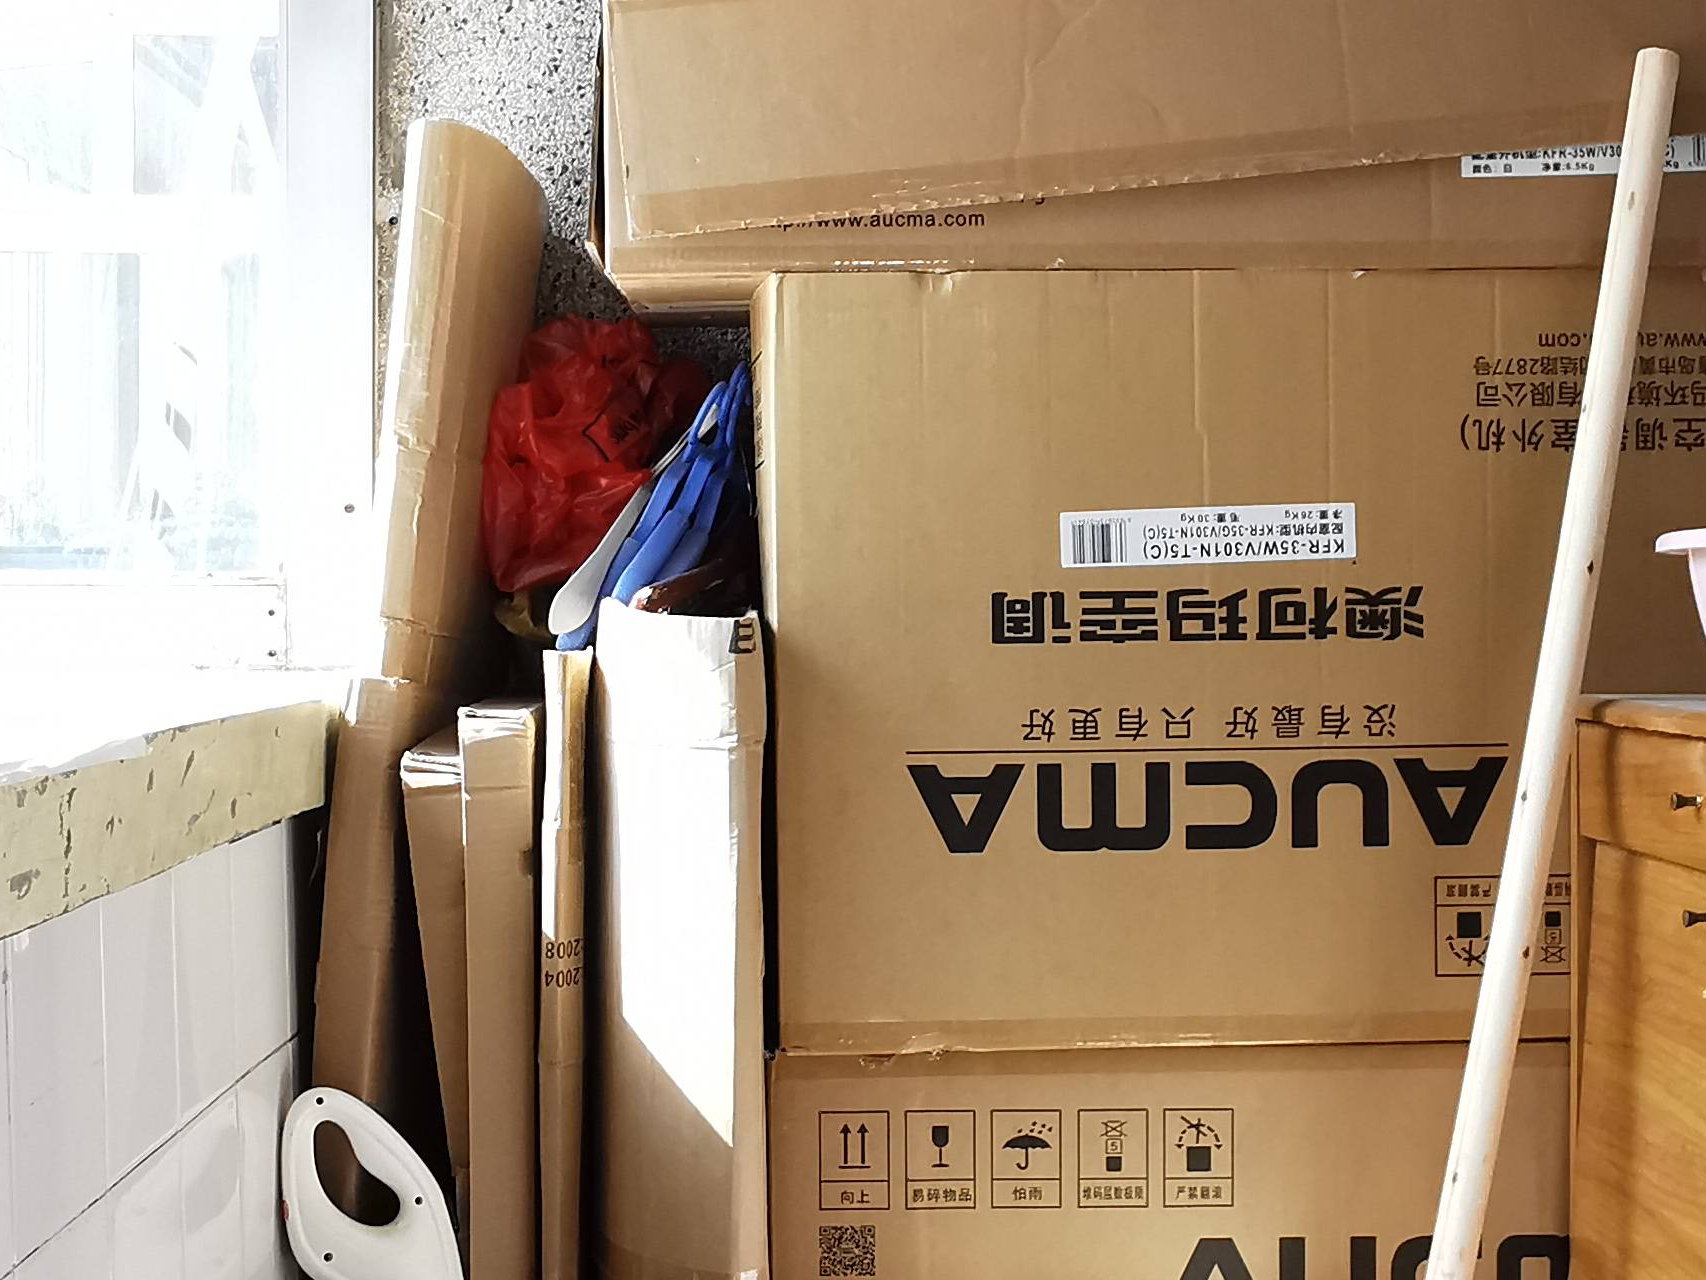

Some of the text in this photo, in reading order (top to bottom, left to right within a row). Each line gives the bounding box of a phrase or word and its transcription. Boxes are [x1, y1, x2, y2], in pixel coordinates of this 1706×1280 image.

[1142, 538, 1345, 560] KFR-35W/V301N-T5(C)
[991, 586, 1425, 644] 澳柯玛空调
[1020, 703, 1397, 743] 没有最好 只有更好
[907, 756, 1509, 854] AUCMA
[839, 1190, 870, 1206] 向上
[912, 1187, 973, 1203] 易碎物品
[1012, 1186, 1043, 1202] 怕雨
